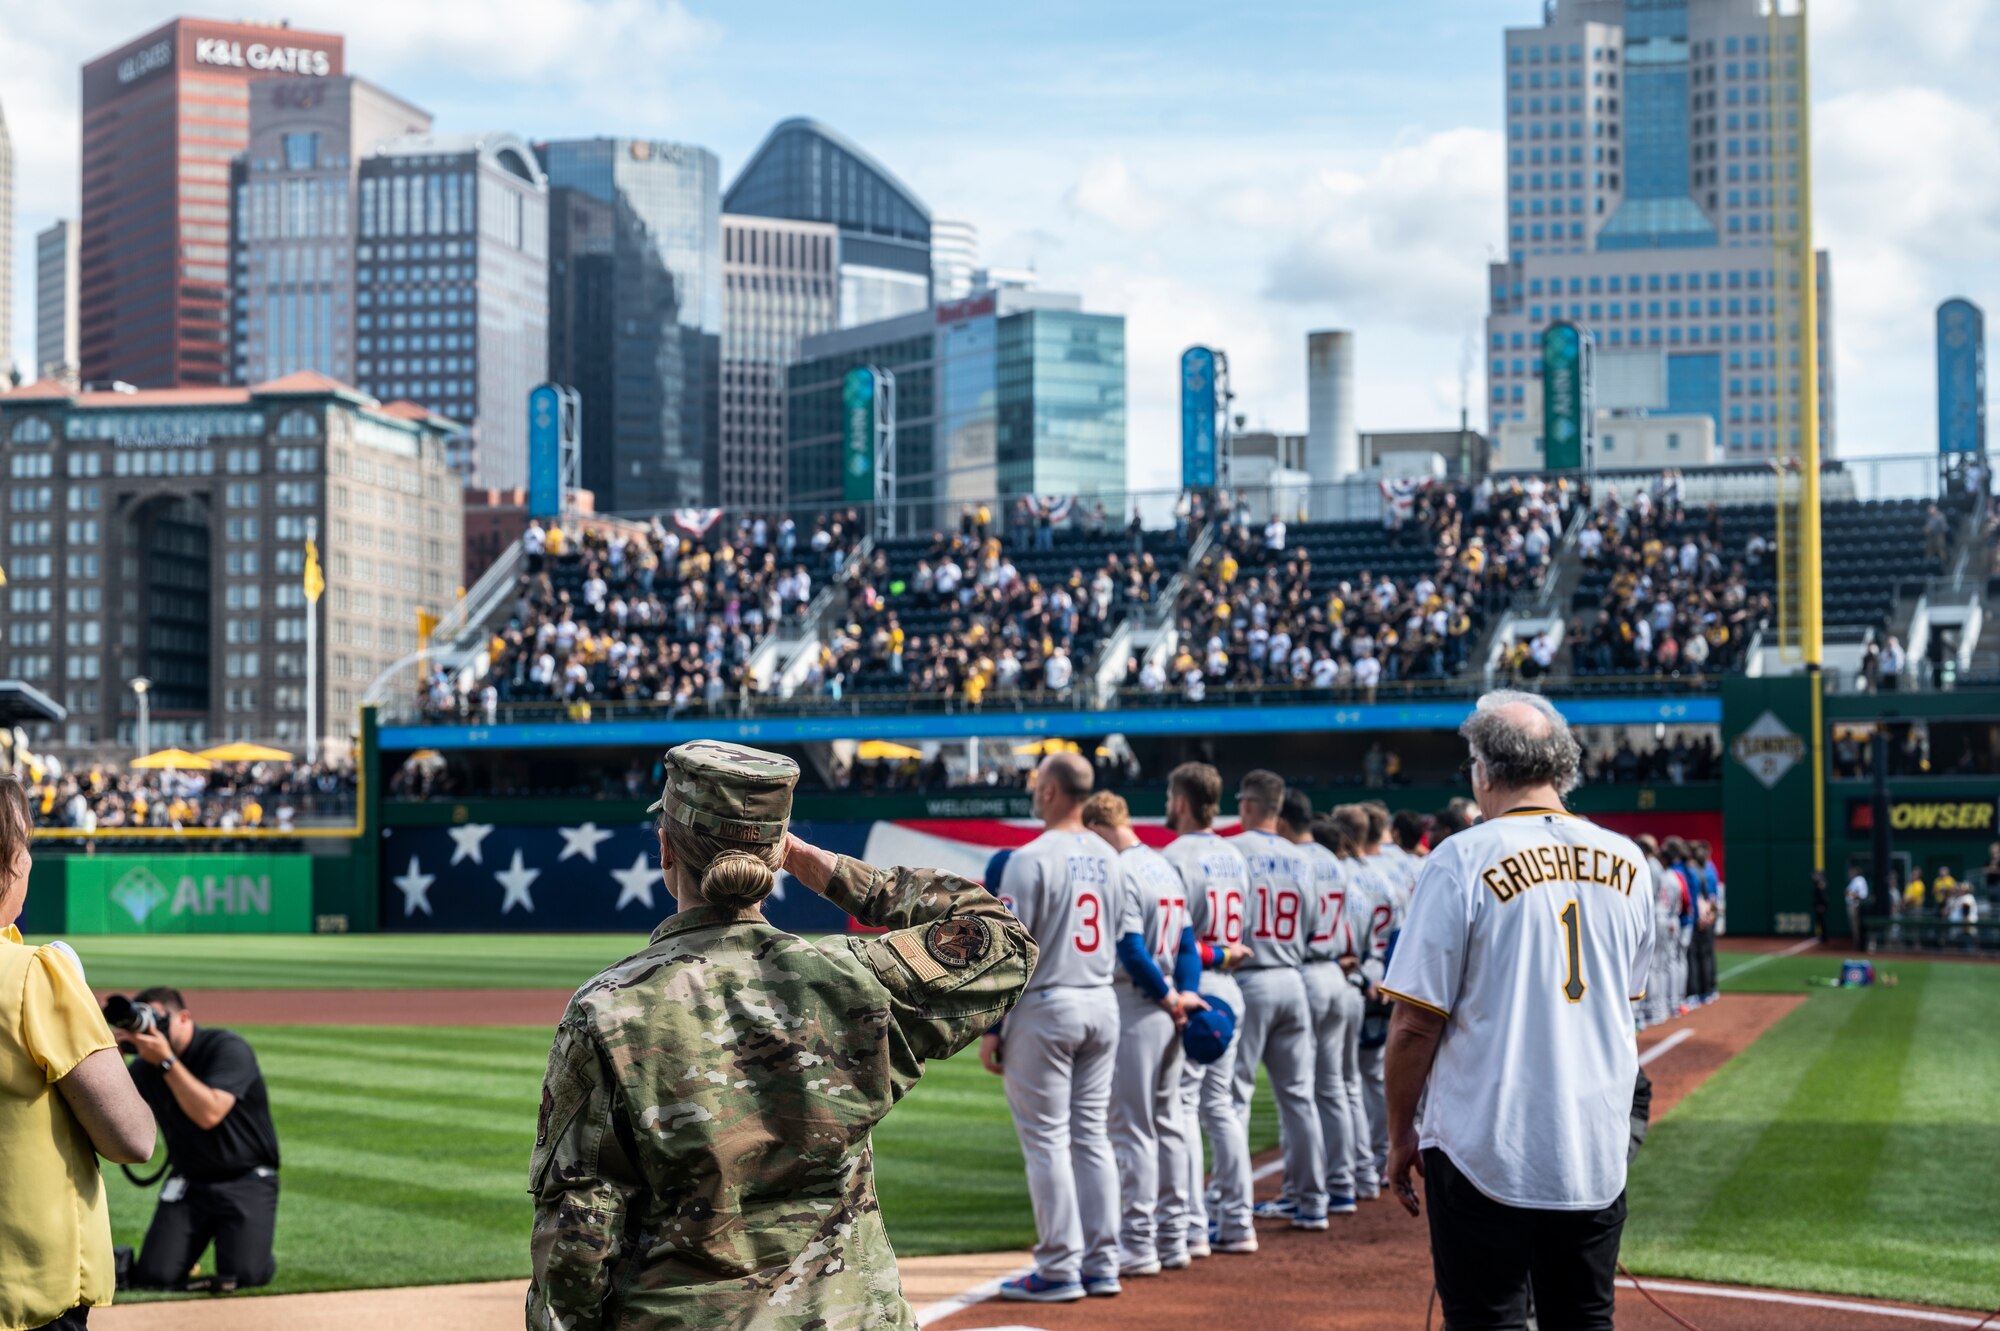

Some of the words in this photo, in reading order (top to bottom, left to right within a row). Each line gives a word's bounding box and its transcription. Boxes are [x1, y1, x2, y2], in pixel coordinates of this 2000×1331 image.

[196, 37, 245, 67] K&L
[246, 43, 330, 77] GATES
[720, 821, 761, 841] NORRIS
[926, 799, 1004, 816] WELCOME
[1888, 802, 1993, 829] OWSER
[170, 874, 271, 916] AHN
[1483, 845, 1637, 903] GRUSHECKY
[1073, 891, 1101, 956] 3
[1202, 889, 1242, 943] 16
[1254, 887, 1299, 942] 18
[1560, 901, 1587, 1003] 1
